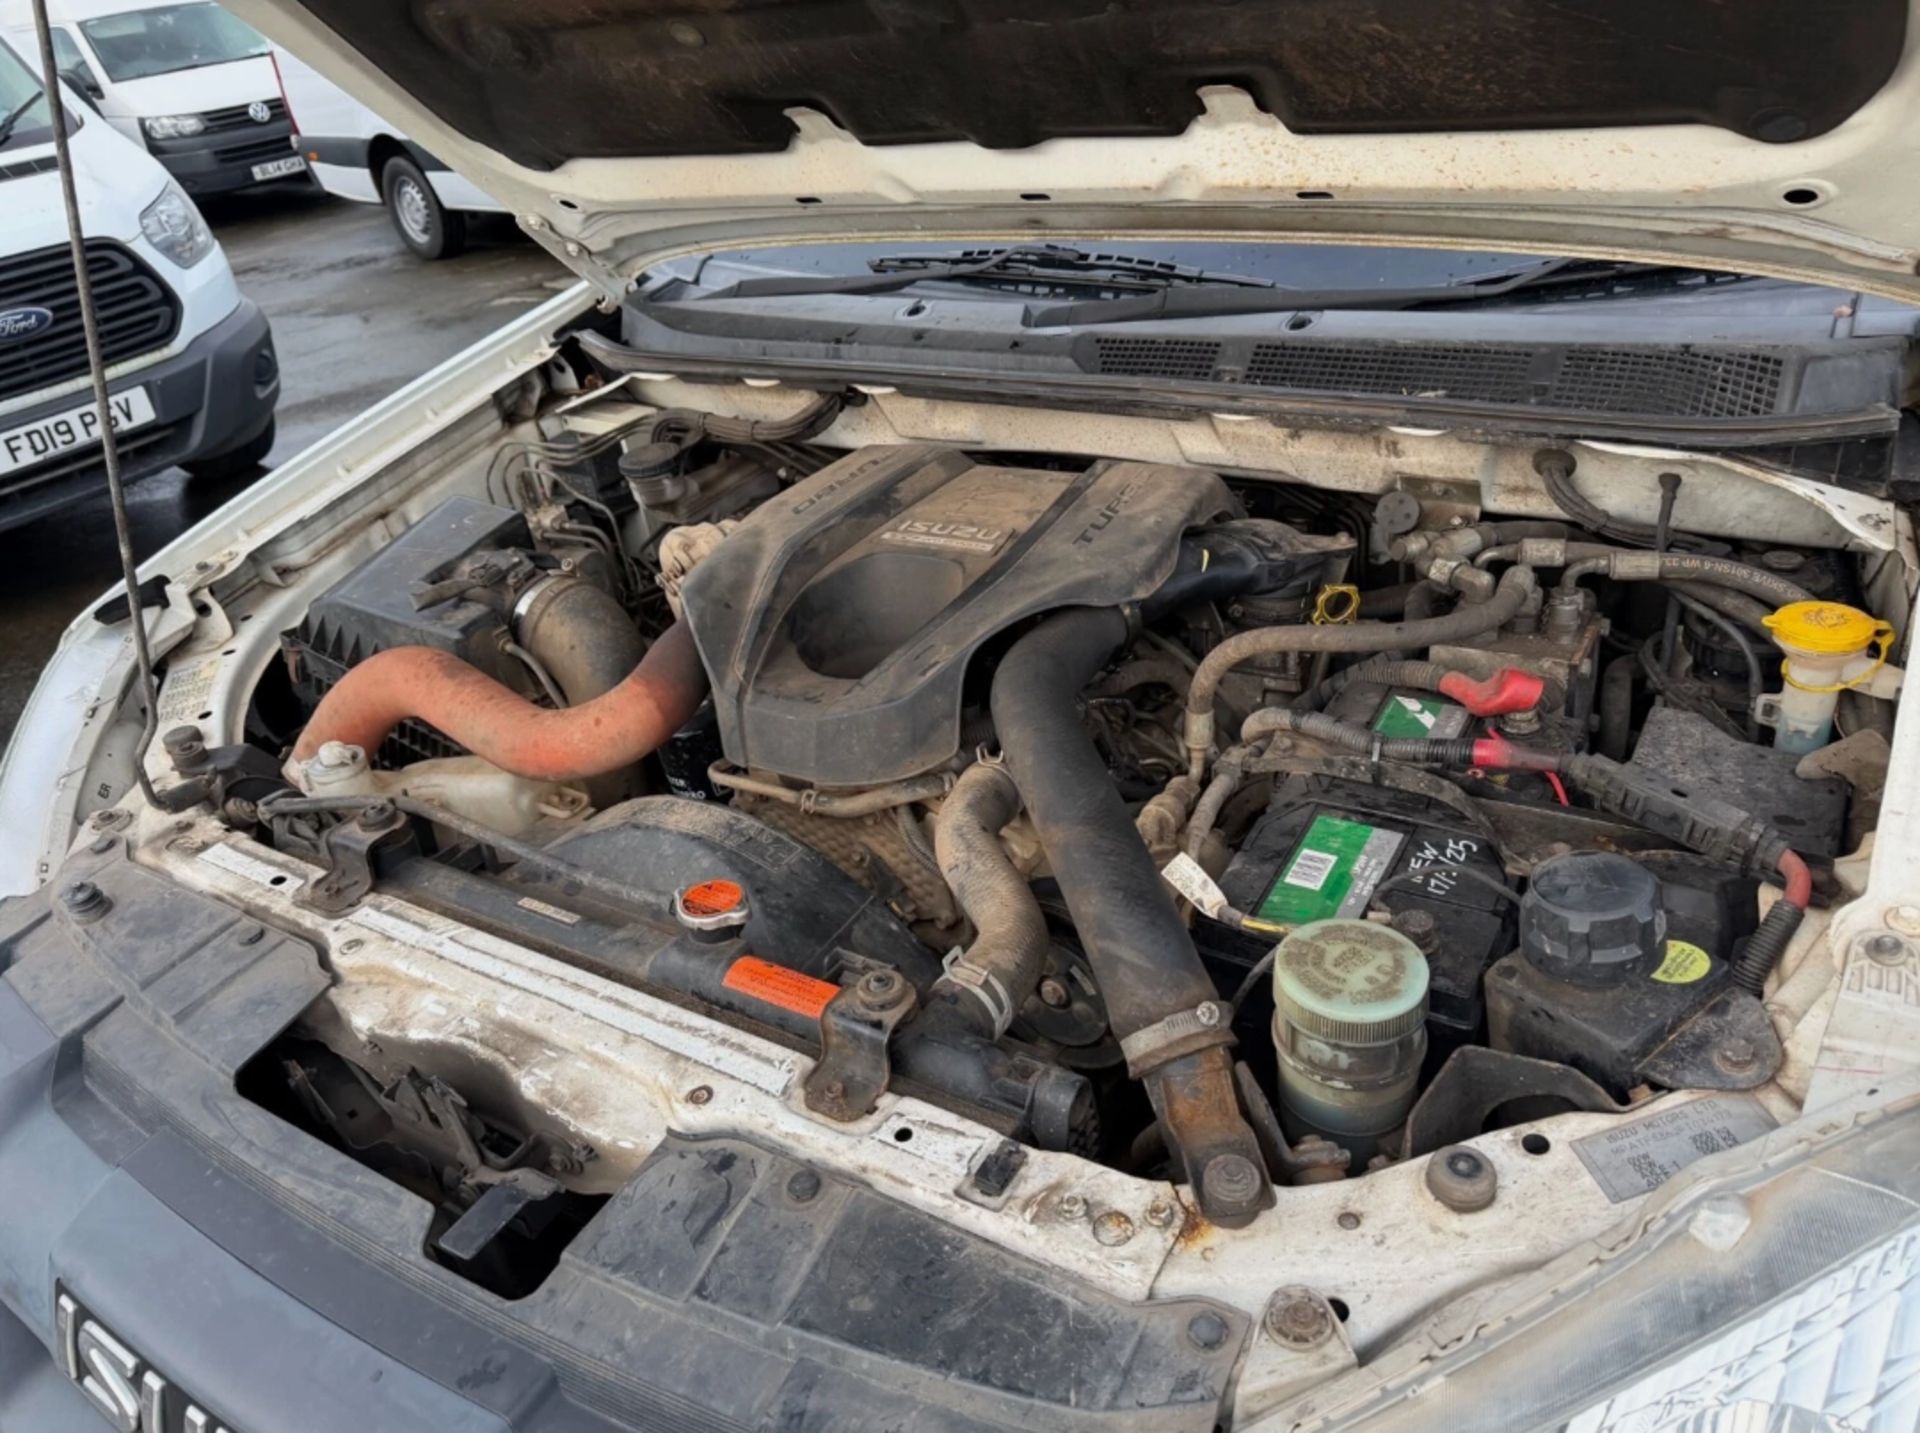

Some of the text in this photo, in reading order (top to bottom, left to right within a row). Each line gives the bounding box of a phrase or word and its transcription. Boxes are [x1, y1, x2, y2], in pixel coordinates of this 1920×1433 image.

[4, 419, 76, 463] FD19
[897, 520, 1001, 540] ISUZU
[1605, 1127, 1639, 1144] ISUZU
[1643, 1110, 1689, 1131] MOTORS
